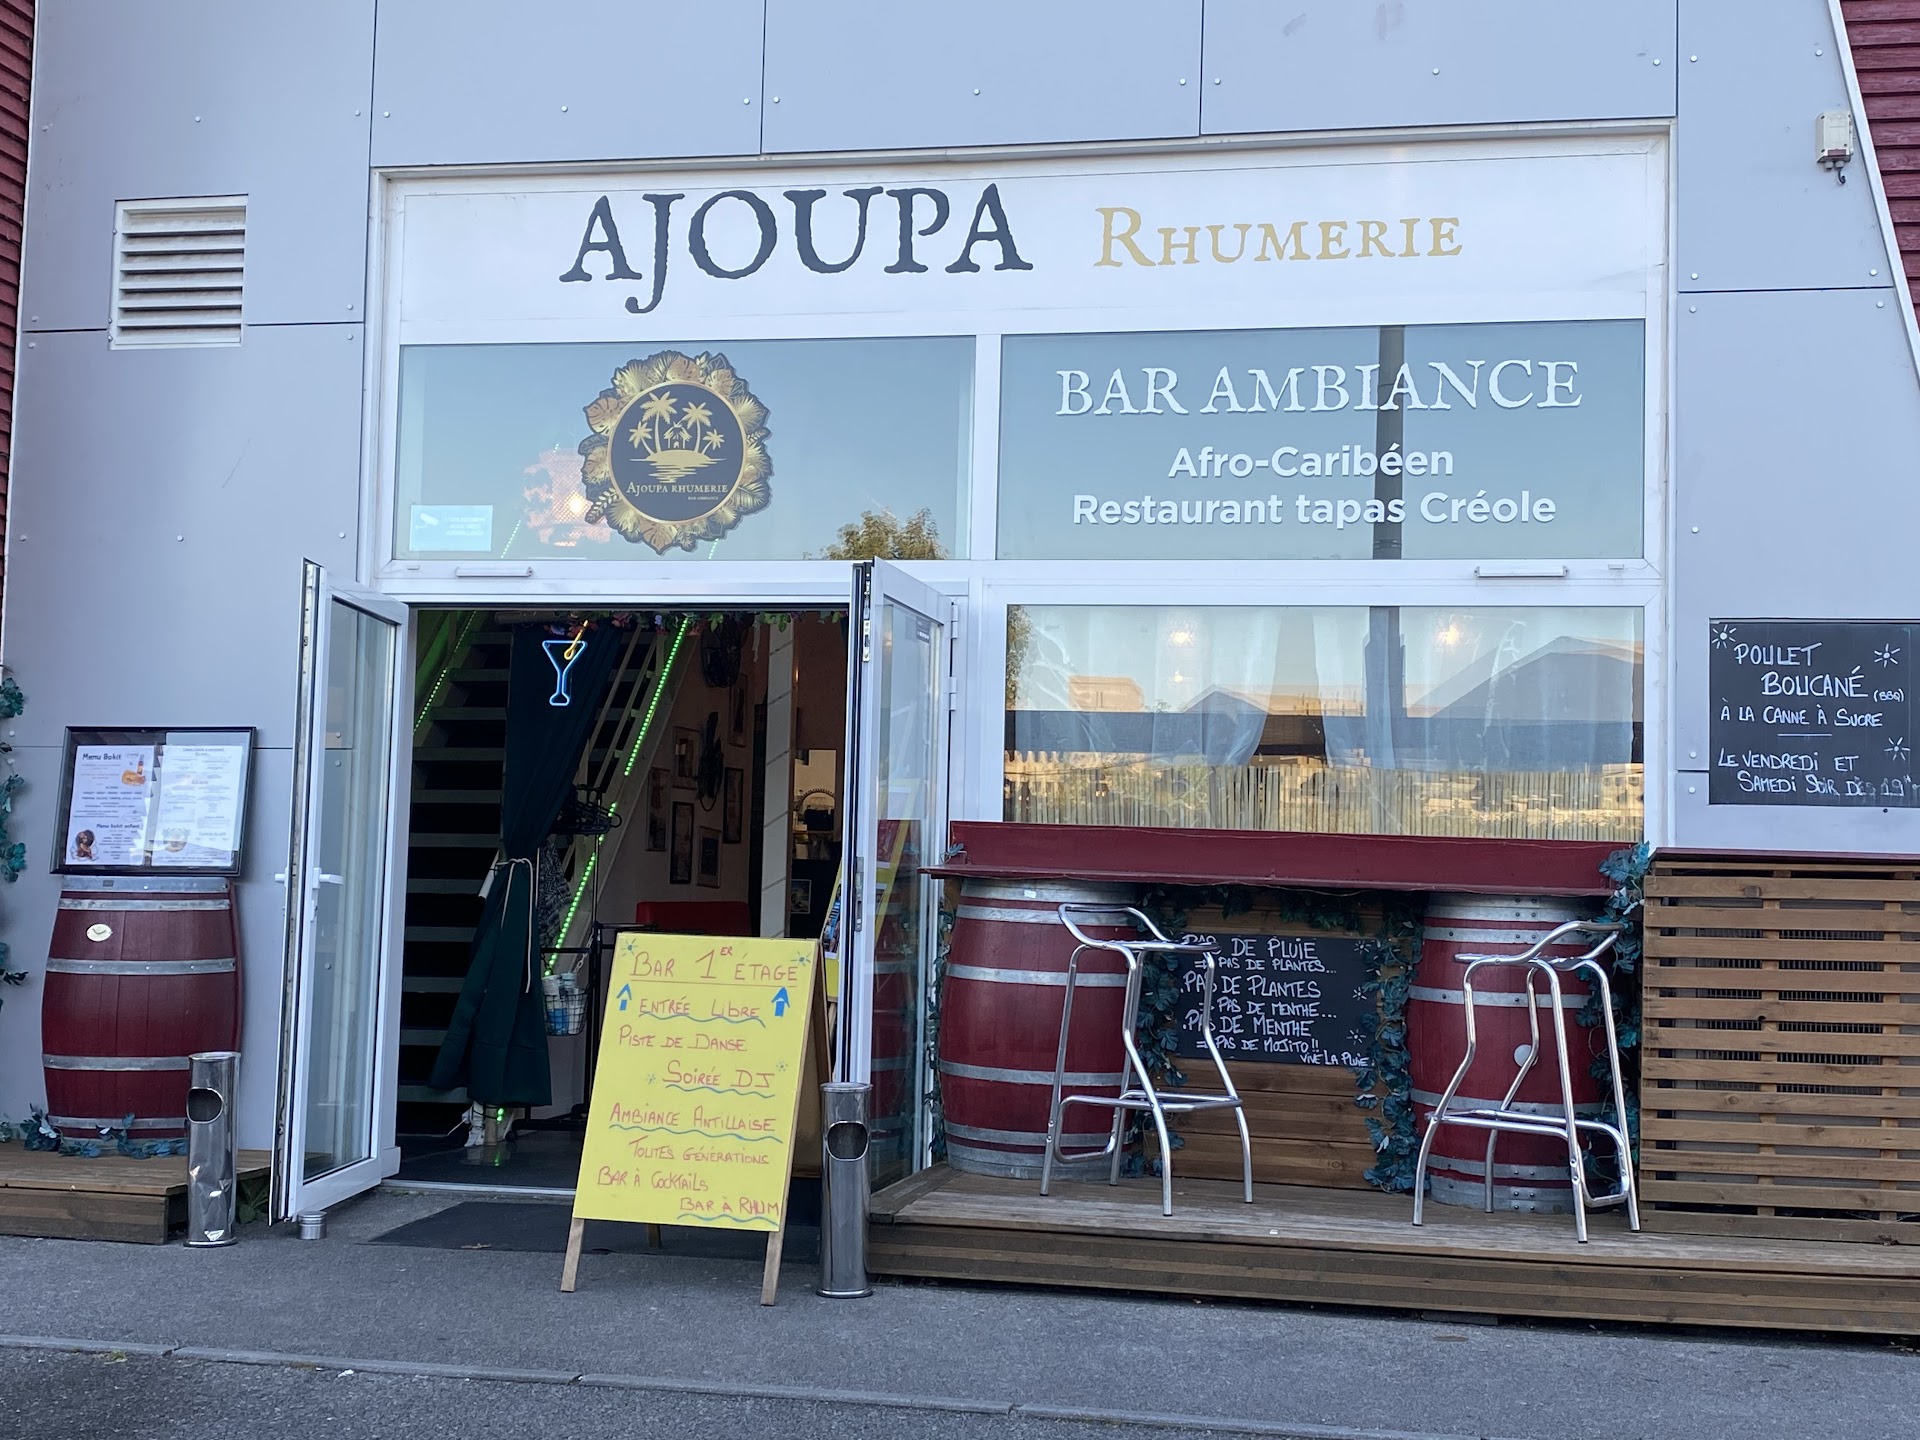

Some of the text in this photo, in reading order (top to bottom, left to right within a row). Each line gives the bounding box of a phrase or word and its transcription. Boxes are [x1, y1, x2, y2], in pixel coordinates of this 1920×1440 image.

[559, 183, 1463, 313] AJOUPA RHUMERIE
[1055, 359, 1584, 415] BAR AMBIANCE
[1168, 442, 1454, 478] Afro-Caribéen
[1073, 490, 1557, 529] Restaurant tapas Créole
[1733, 642, 1823, 666] POULET
[1761, 665, 1868, 698] BOUCANÉ
[1720, 697, 1883, 727] À LA CANNE À SUCRE
[82, 753, 102, 761] Menu
[103, 752, 122, 761] Bokit
[1718, 748, 1739, 767] LE
[1834, 755, 1860, 772] ET
[1231, 937, 1257, 957] DE
[630, 951, 675, 978] BAR
[734, 953, 799, 982] ÉTAGE
[1218, 956, 1240, 970] PAS
[1245, 958, 1265, 971] DE
[1221, 975, 1242, 995] DE
[1247, 974, 1322, 998] PLANTES
[639, 996, 690, 1015] ENTRÉE
[1217, 996, 1241, 1013] PAS
[1246, 1000, 1266, 1016] DE
[1219, 1015, 1244, 1034] DE
[1253, 1018, 1315, 1037] MENTHE
[664, 1036, 683, 1049] DE
[687, 1033, 748, 1052] DANSE
[1215, 1035, 1236, 1050] PAS
[1241, 1039, 1259, 1051] DE
[730, 1069, 776, 1089] DJ
[629, 1135, 675, 1160] TOUTES
[597, 1165, 628, 1186] BAR
[680, 1197, 714, 1212] BAR
[739, 1197, 780, 1216] RHUM
